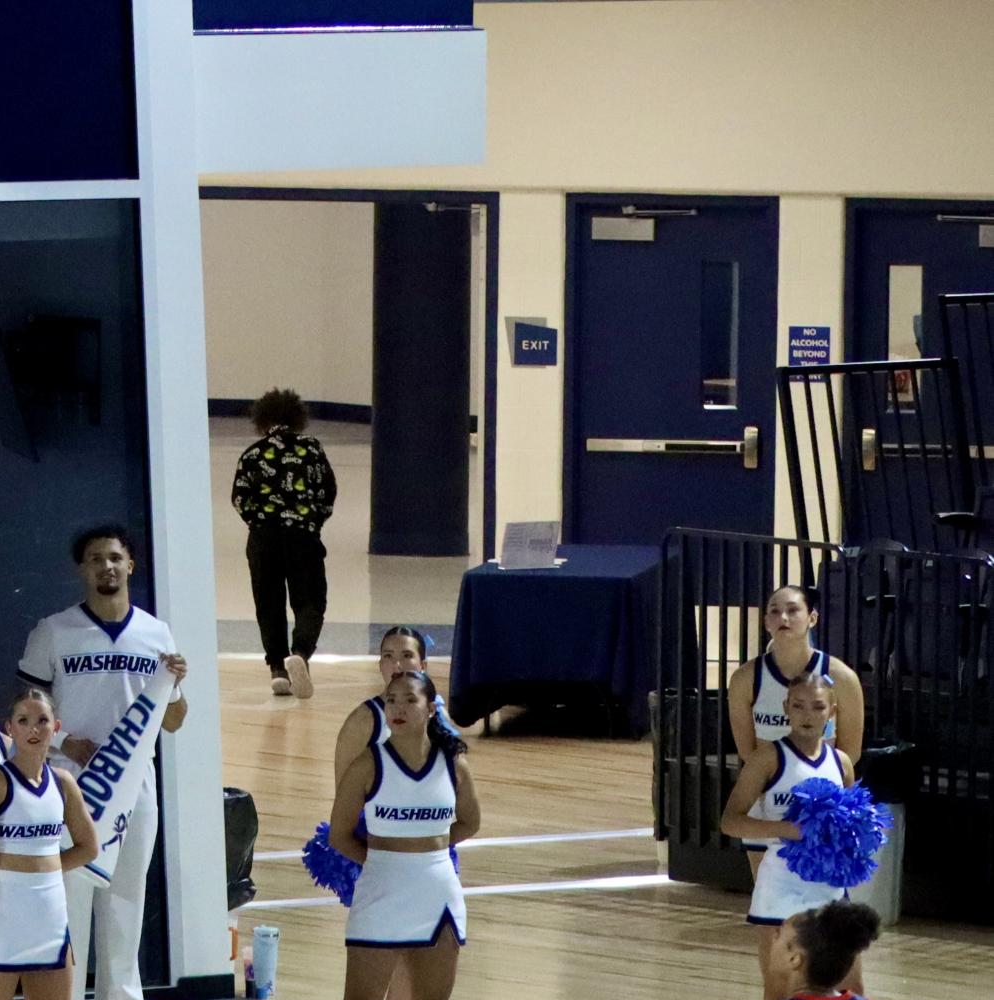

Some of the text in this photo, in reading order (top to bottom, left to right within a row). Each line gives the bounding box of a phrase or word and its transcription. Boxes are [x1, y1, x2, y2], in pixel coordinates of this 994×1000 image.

[803, 328, 817, 336] NO
[521, 340, 550, 350] EXIT
[790, 339, 829, 347] ALCOHOL
[793, 350, 827, 358] BEYOND
[63, 654, 159, 676] WASHBURN
[754, 713, 790, 726] WASH
[374, 805, 454, 820] WASHBURN
[0, 824, 62, 838] WASHBU
